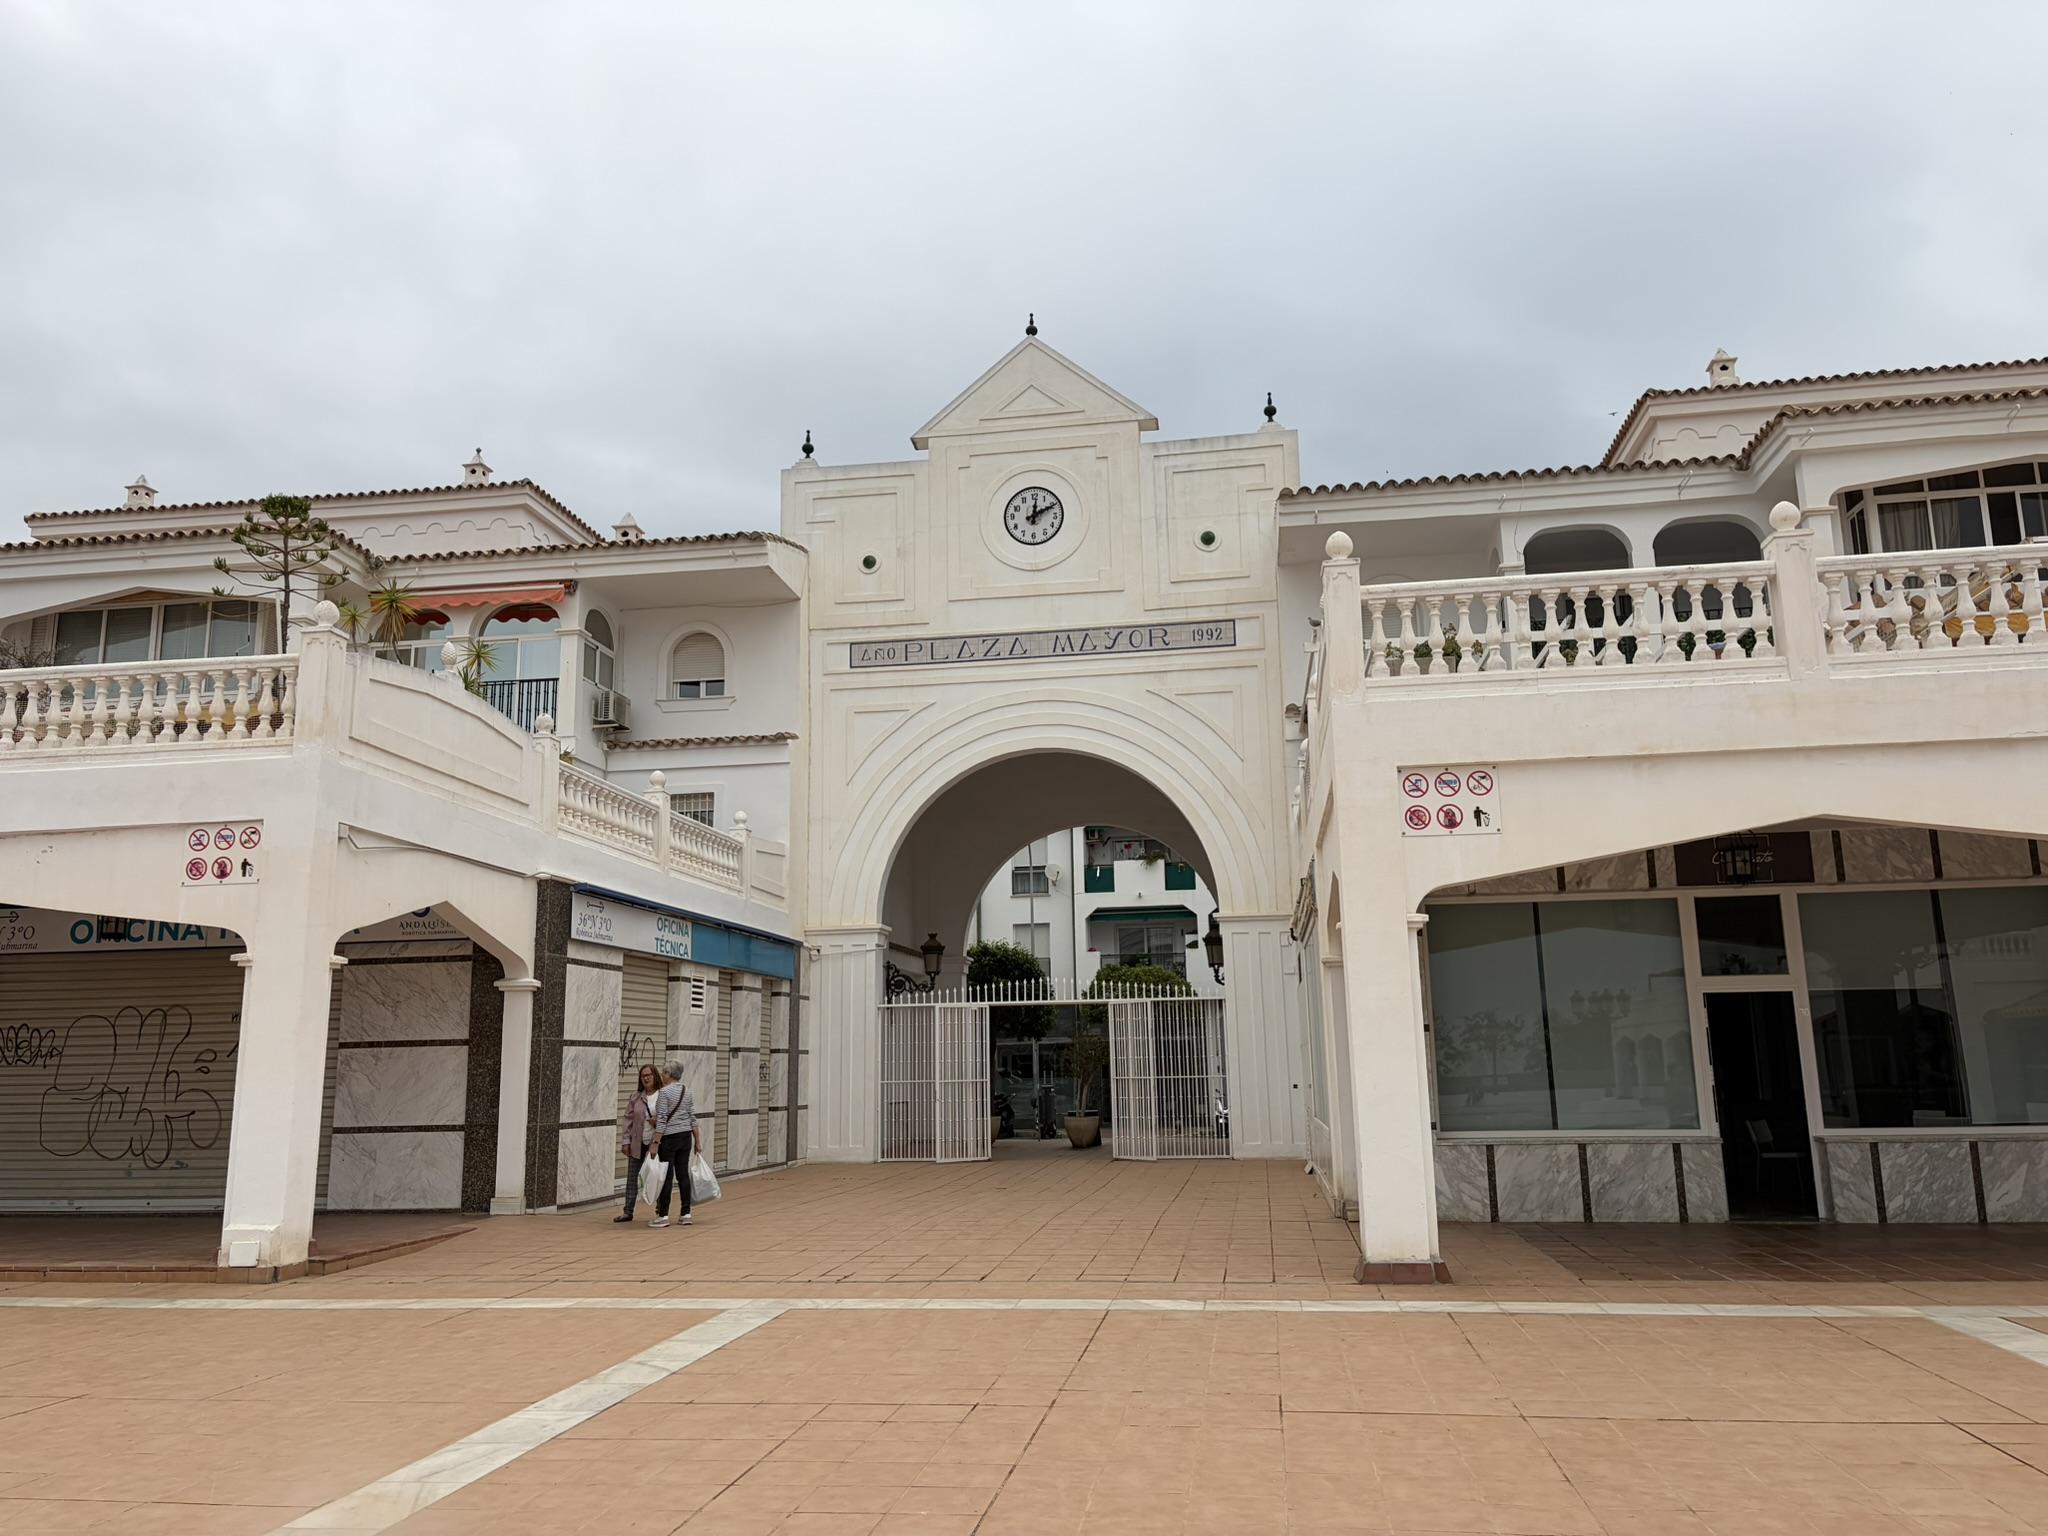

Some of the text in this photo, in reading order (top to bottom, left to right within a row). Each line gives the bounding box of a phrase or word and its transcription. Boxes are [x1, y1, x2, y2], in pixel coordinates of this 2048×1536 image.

[1021, 496, 1027, 504] 11
[1031, 492, 1039, 501] 12
[1013, 505, 1021, 513] 10
[1010, 513, 1015, 521] 9
[1052, 512, 1058, 520] 3
[1013, 523, 1018, 531] 8
[1049, 521, 1055, 529] 4
[1020, 529, 1026, 537] 7
[1031, 532, 1036, 540] 6
[861, 627, 1223, 662] AÑO PLAZA MAYOR 1992
[70, 918, 204, 944] OCINA
[656, 917, 689, 938] OFICINA
[0, 942, 38, 950] ubmarina
[654, 934, 689, 958] TÉCNICA
